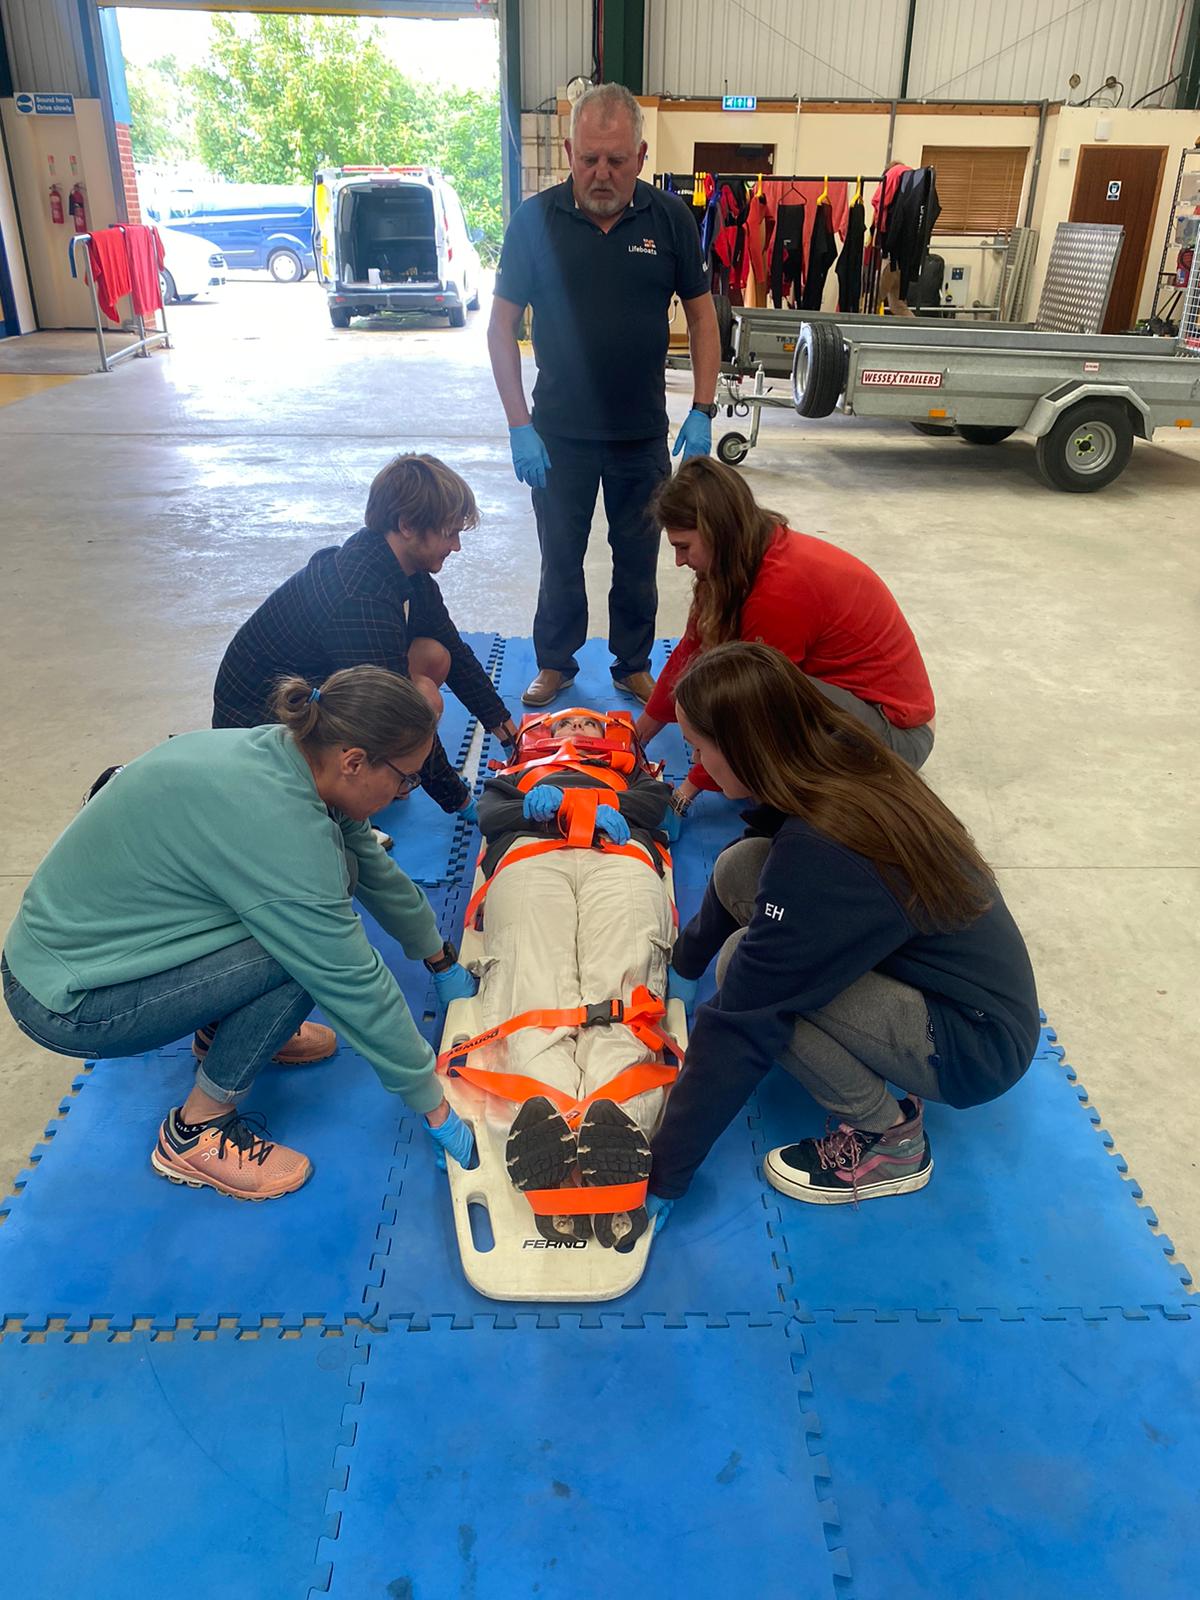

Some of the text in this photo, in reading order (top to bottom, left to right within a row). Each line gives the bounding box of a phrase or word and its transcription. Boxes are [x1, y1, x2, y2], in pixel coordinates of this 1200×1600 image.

[628, 245, 657, 255] Lifeboats
[864, 373, 940, 385] WESSEX TRAILERS
[765, 902, 785, 921] EH
[522, 1239, 588, 1249] FERNO
